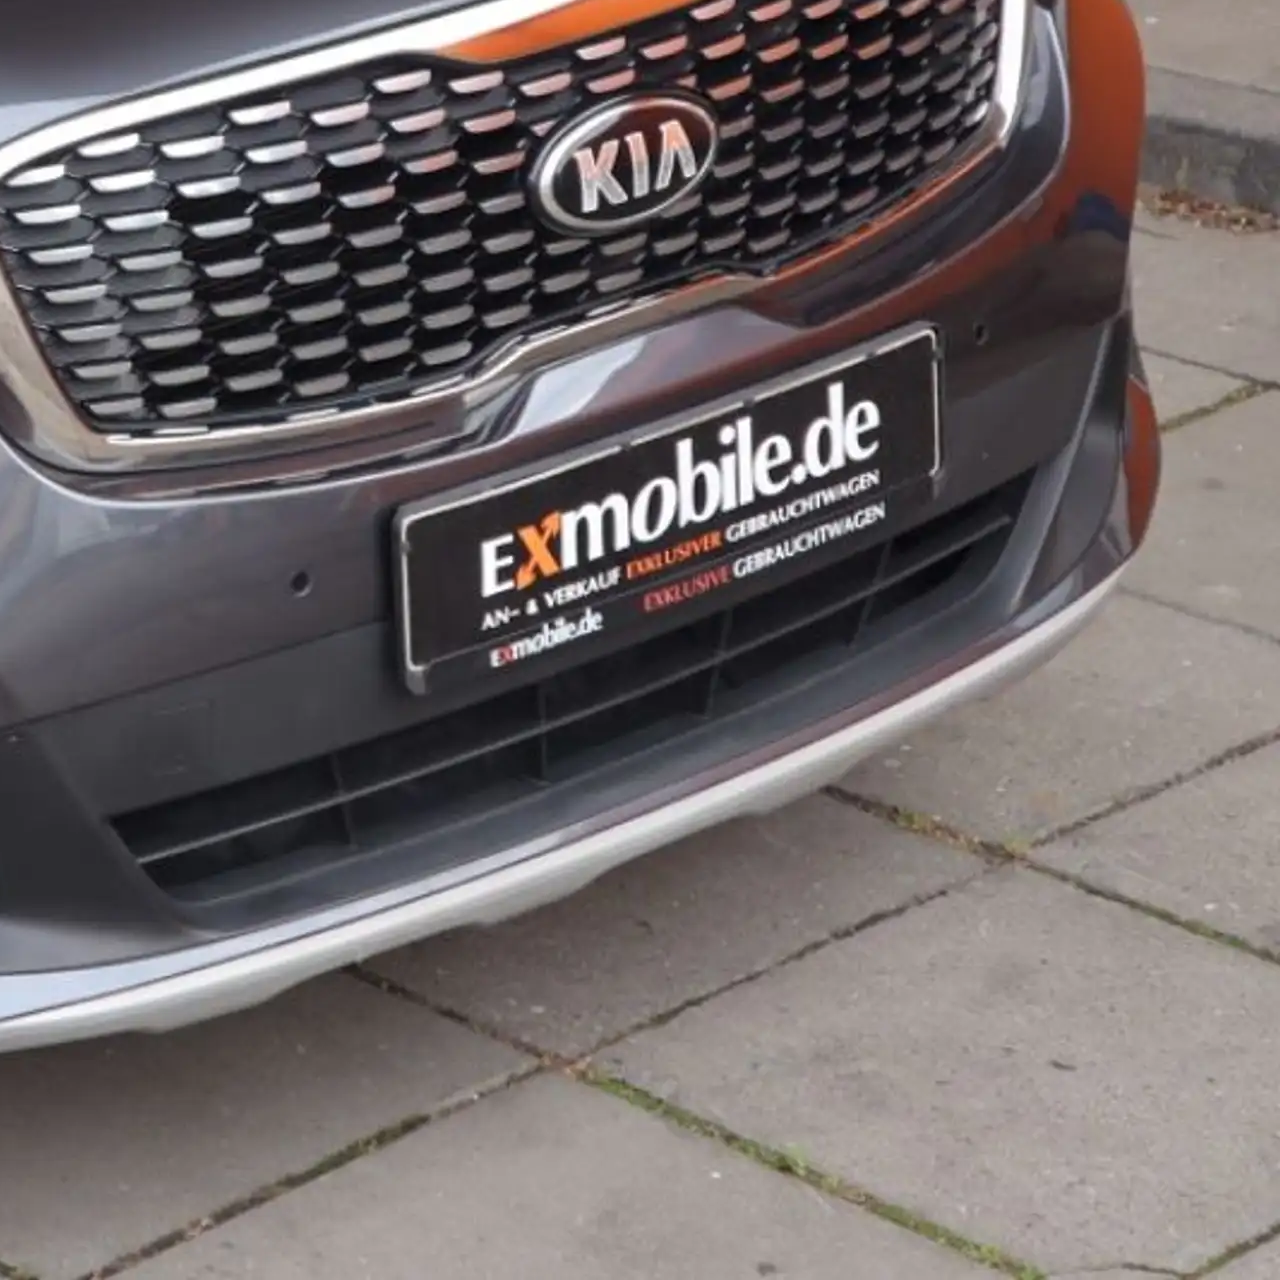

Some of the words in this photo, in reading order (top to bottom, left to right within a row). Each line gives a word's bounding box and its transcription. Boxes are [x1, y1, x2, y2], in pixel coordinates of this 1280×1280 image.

[573, 119, 697, 214] KIA
[525, 598, 539, 616] &
[542, 565, 622, 609] VERKAUF
[625, 530, 724, 580] EXKLUSIVER
[725, 469, 881, 543] GEBRAUCHTWAGEN
[643, 563, 732, 612] EXKLUSIVE
[732, 501, 887, 578] GEBRAUCHTWAGEN
